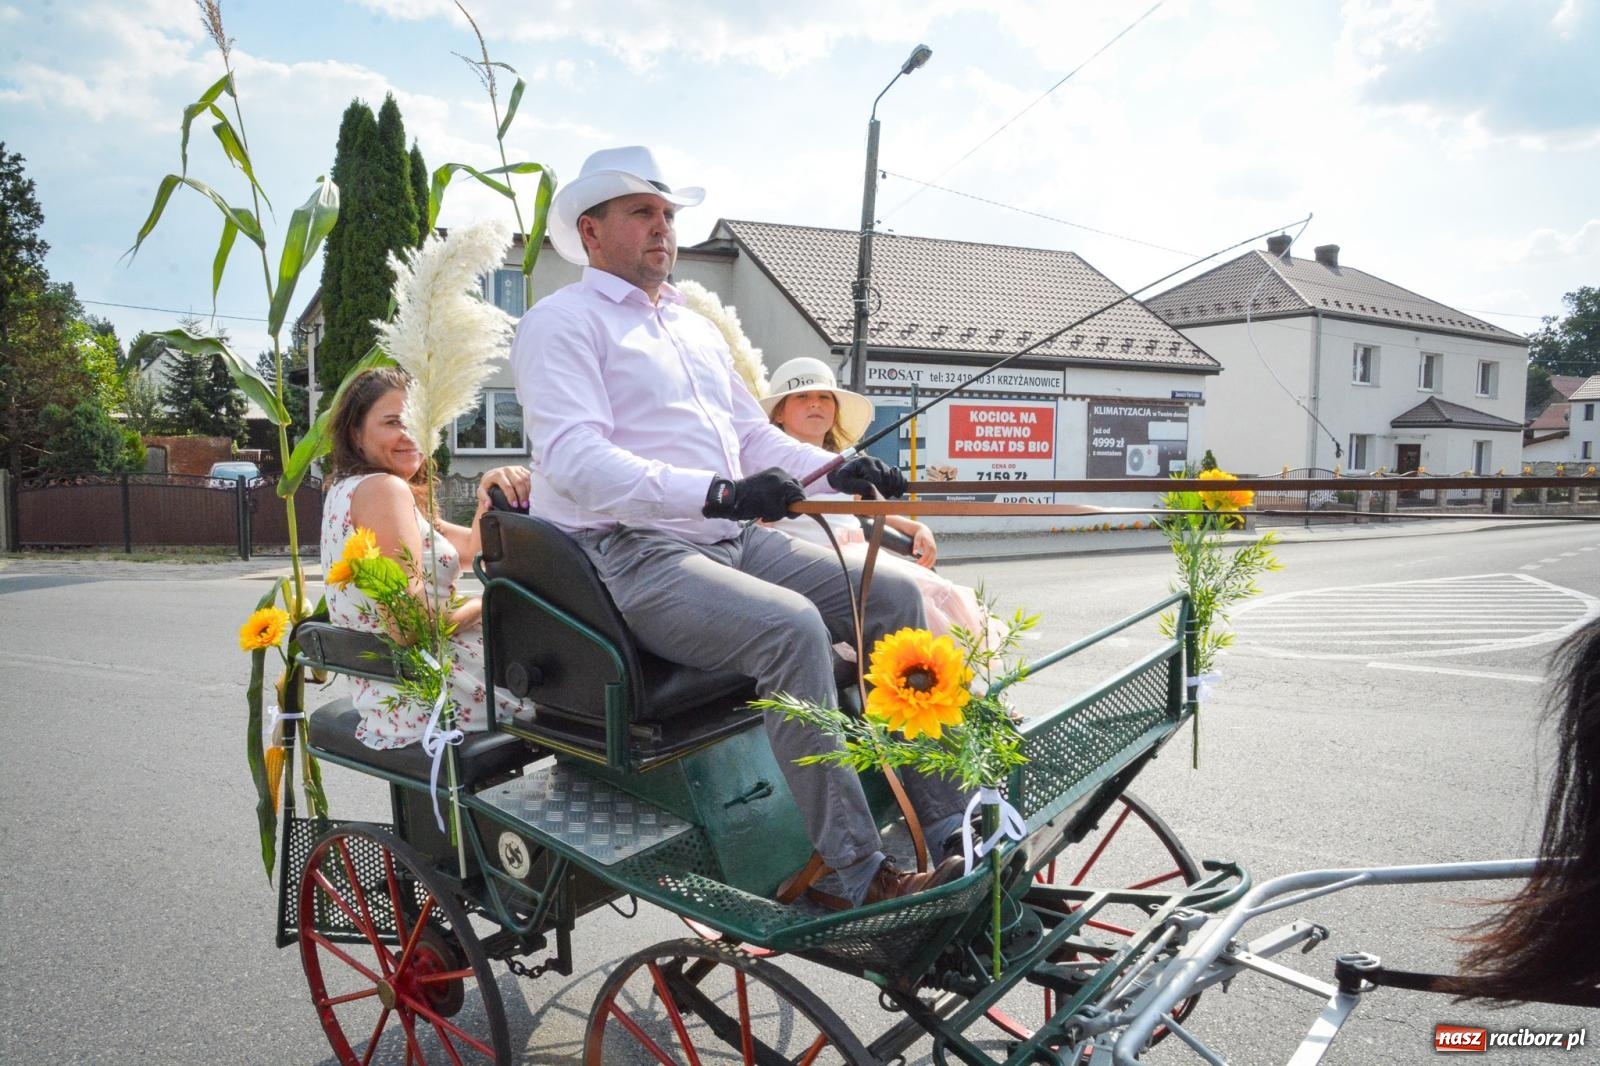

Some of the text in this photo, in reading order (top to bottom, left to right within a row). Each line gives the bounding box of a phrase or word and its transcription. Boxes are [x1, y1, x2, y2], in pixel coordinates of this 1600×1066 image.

[868, 368, 924, 381] PROSAT
[930, 371, 944, 383] tel:
[945, 372, 956, 383] 32
[986, 374, 996, 385] 31
[997, 374, 1061, 388] KRZYŻANOWICE
[969, 410, 1038, 424] KOCIOŁ NA
[1093, 406, 1152, 417] KLIMATYZACJA
[975, 425, 1032, 438] DREWNO
[954, 440, 1051, 453] PROSAT DS BIO
[1092, 437, 1125, 448] 4999 zł
